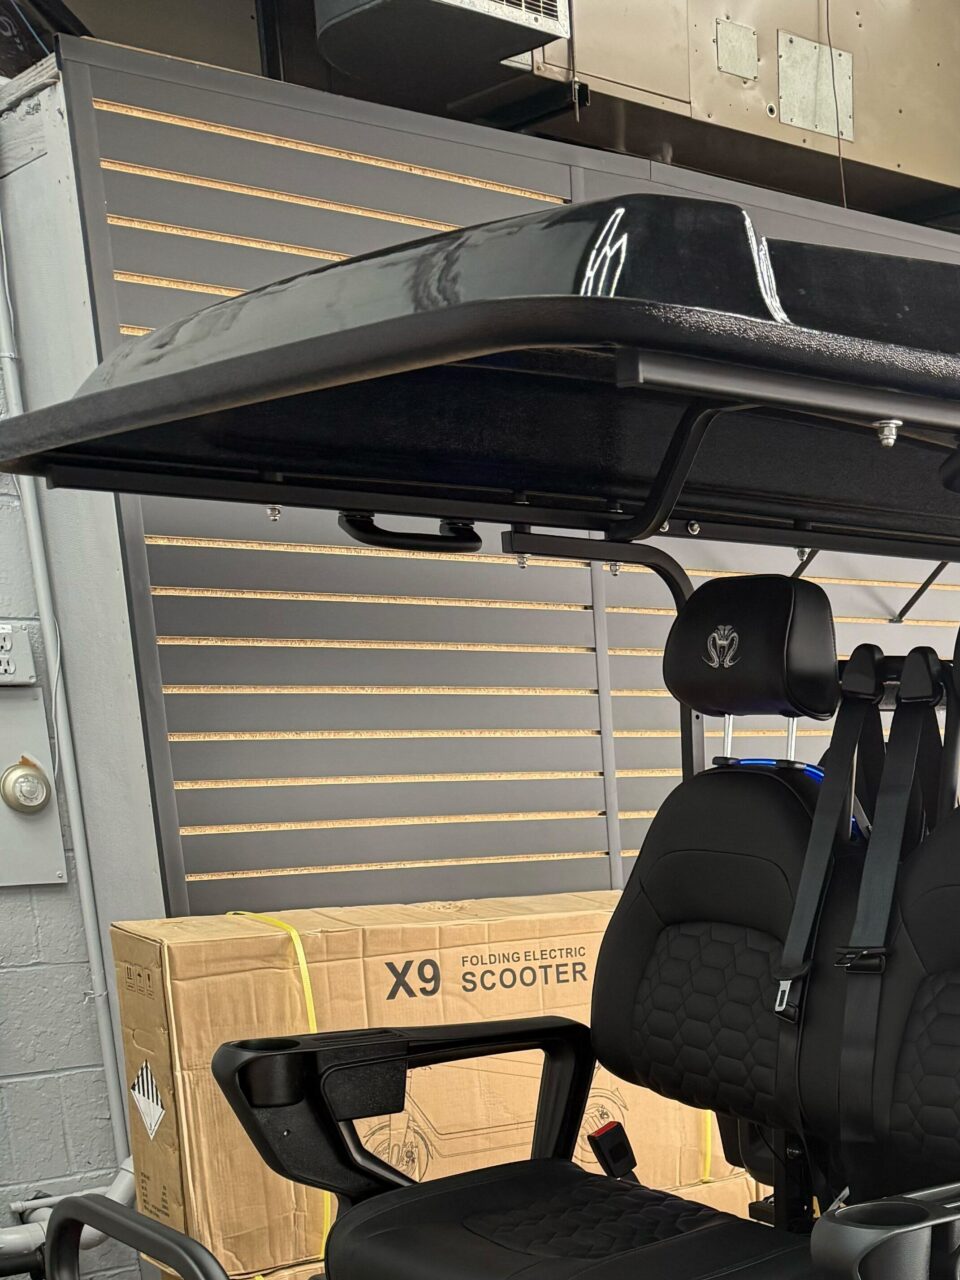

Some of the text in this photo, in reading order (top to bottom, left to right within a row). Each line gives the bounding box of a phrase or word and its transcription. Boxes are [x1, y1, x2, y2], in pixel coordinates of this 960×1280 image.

[461, 946, 586, 967] FOLDING ELECTRIC
[384, 958, 441, 1001] X9
[461, 961, 588, 993] SCOOTER
